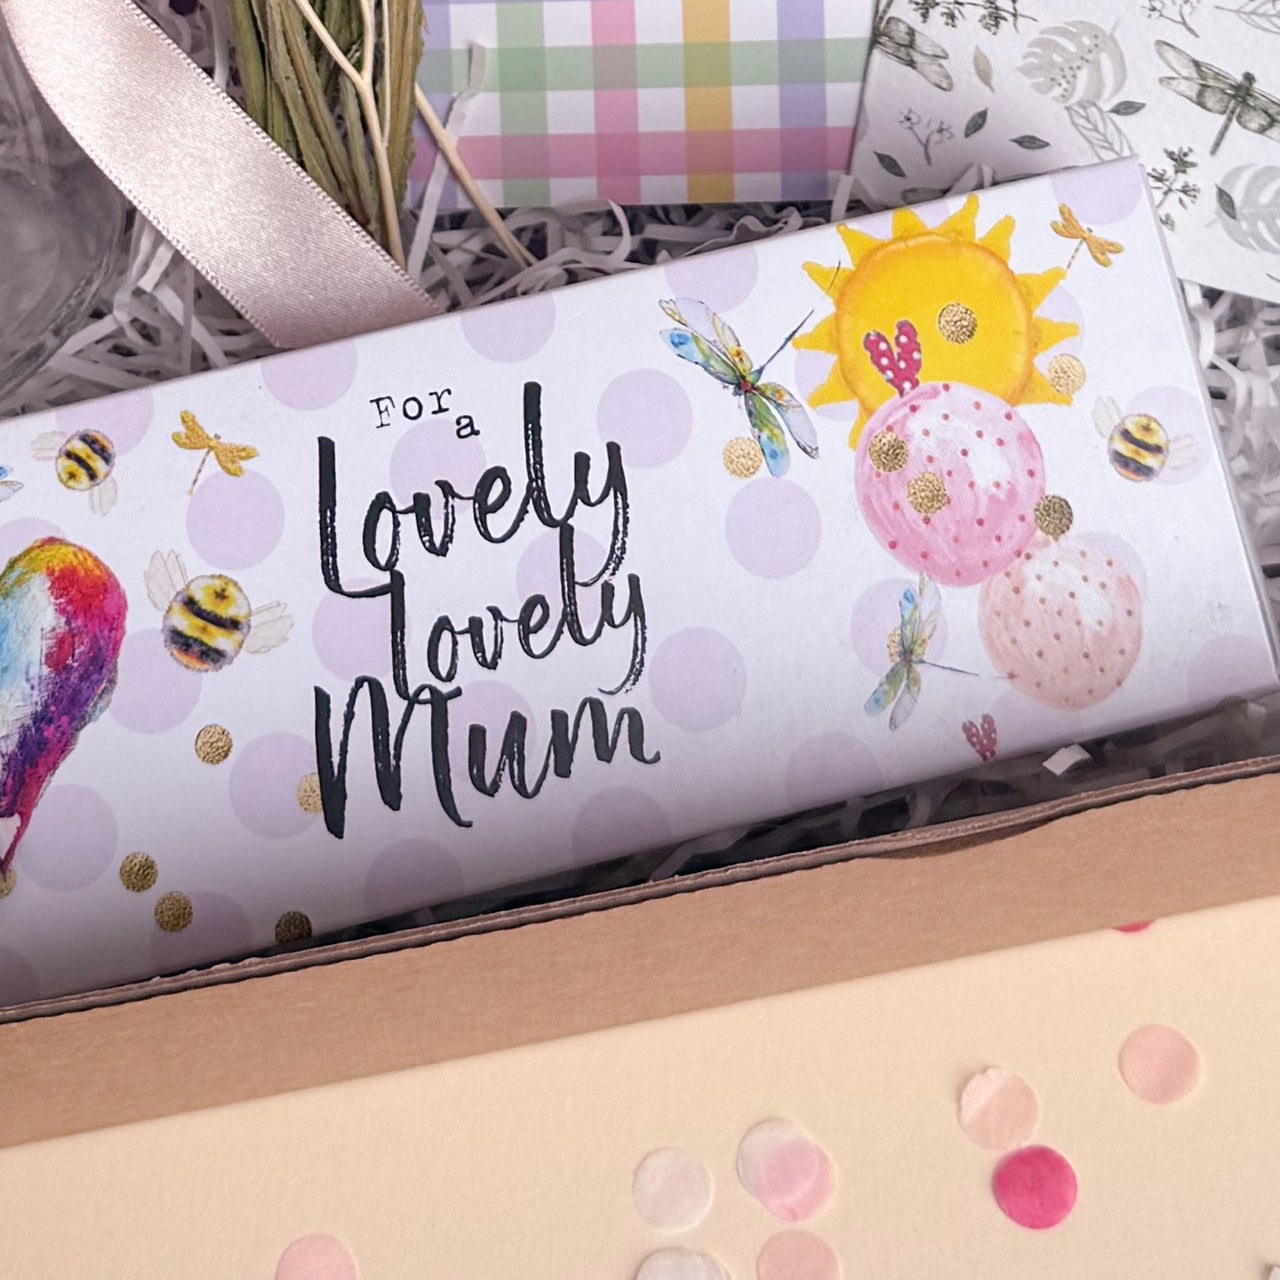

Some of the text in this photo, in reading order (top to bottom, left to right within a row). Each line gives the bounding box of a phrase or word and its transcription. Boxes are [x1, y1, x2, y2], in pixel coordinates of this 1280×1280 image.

[369, 387, 481, 439] For a
[314, 675, 662, 840] Mum
